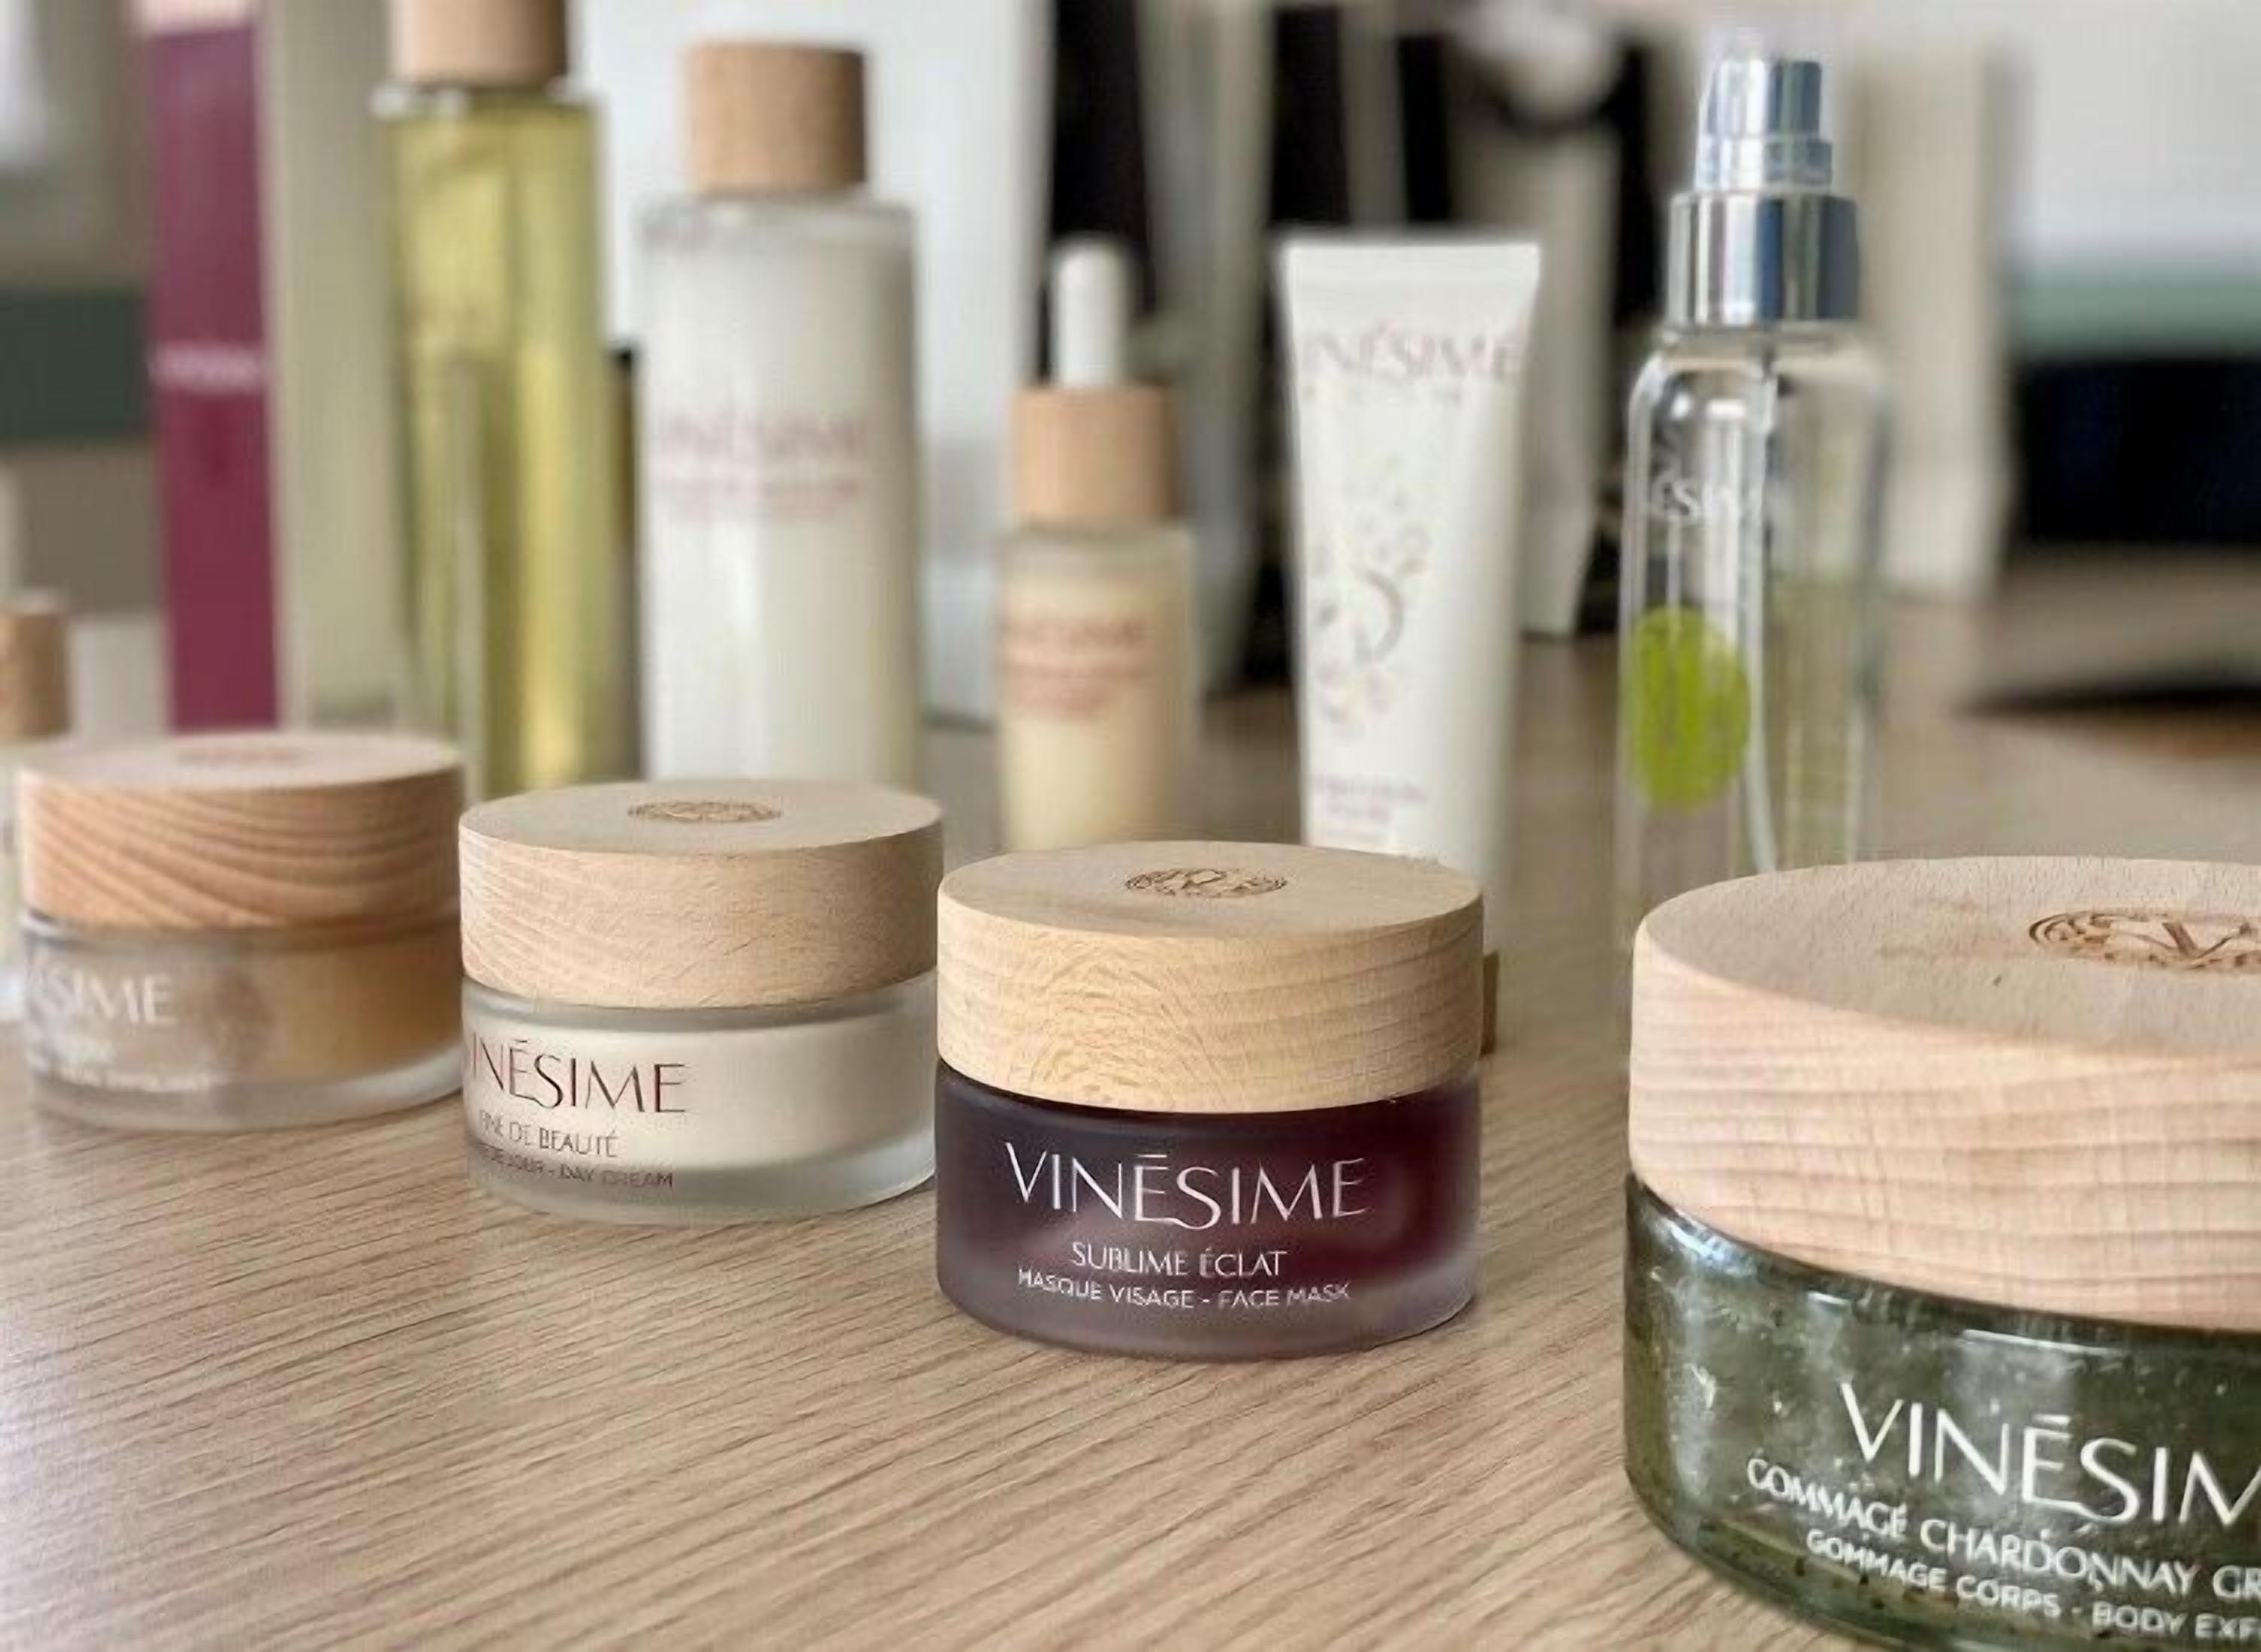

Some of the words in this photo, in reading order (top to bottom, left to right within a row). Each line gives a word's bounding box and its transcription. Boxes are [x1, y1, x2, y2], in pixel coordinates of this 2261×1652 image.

[538, 1127, 621, 1158] BEAUTÉ
[1071, 1240, 1190, 1277] SUBLIME
[1199, 1247, 1288, 1277] ÉCLAT
[1017, 1268, 1103, 1302] MASQUE
[1109, 1284, 1195, 1310] VISAGE
[1218, 1289, 1280, 1310] FACE
[1286, 1282, 1351, 1306] MASK
[1919, 1517, 2202, 1596] CHARDONNAY
[1806, 1527, 1948, 1593] GOMMAGE
[1955, 1575, 2061, 1619] CORPS
[2091, 1599, 2187, 1636] BODY
